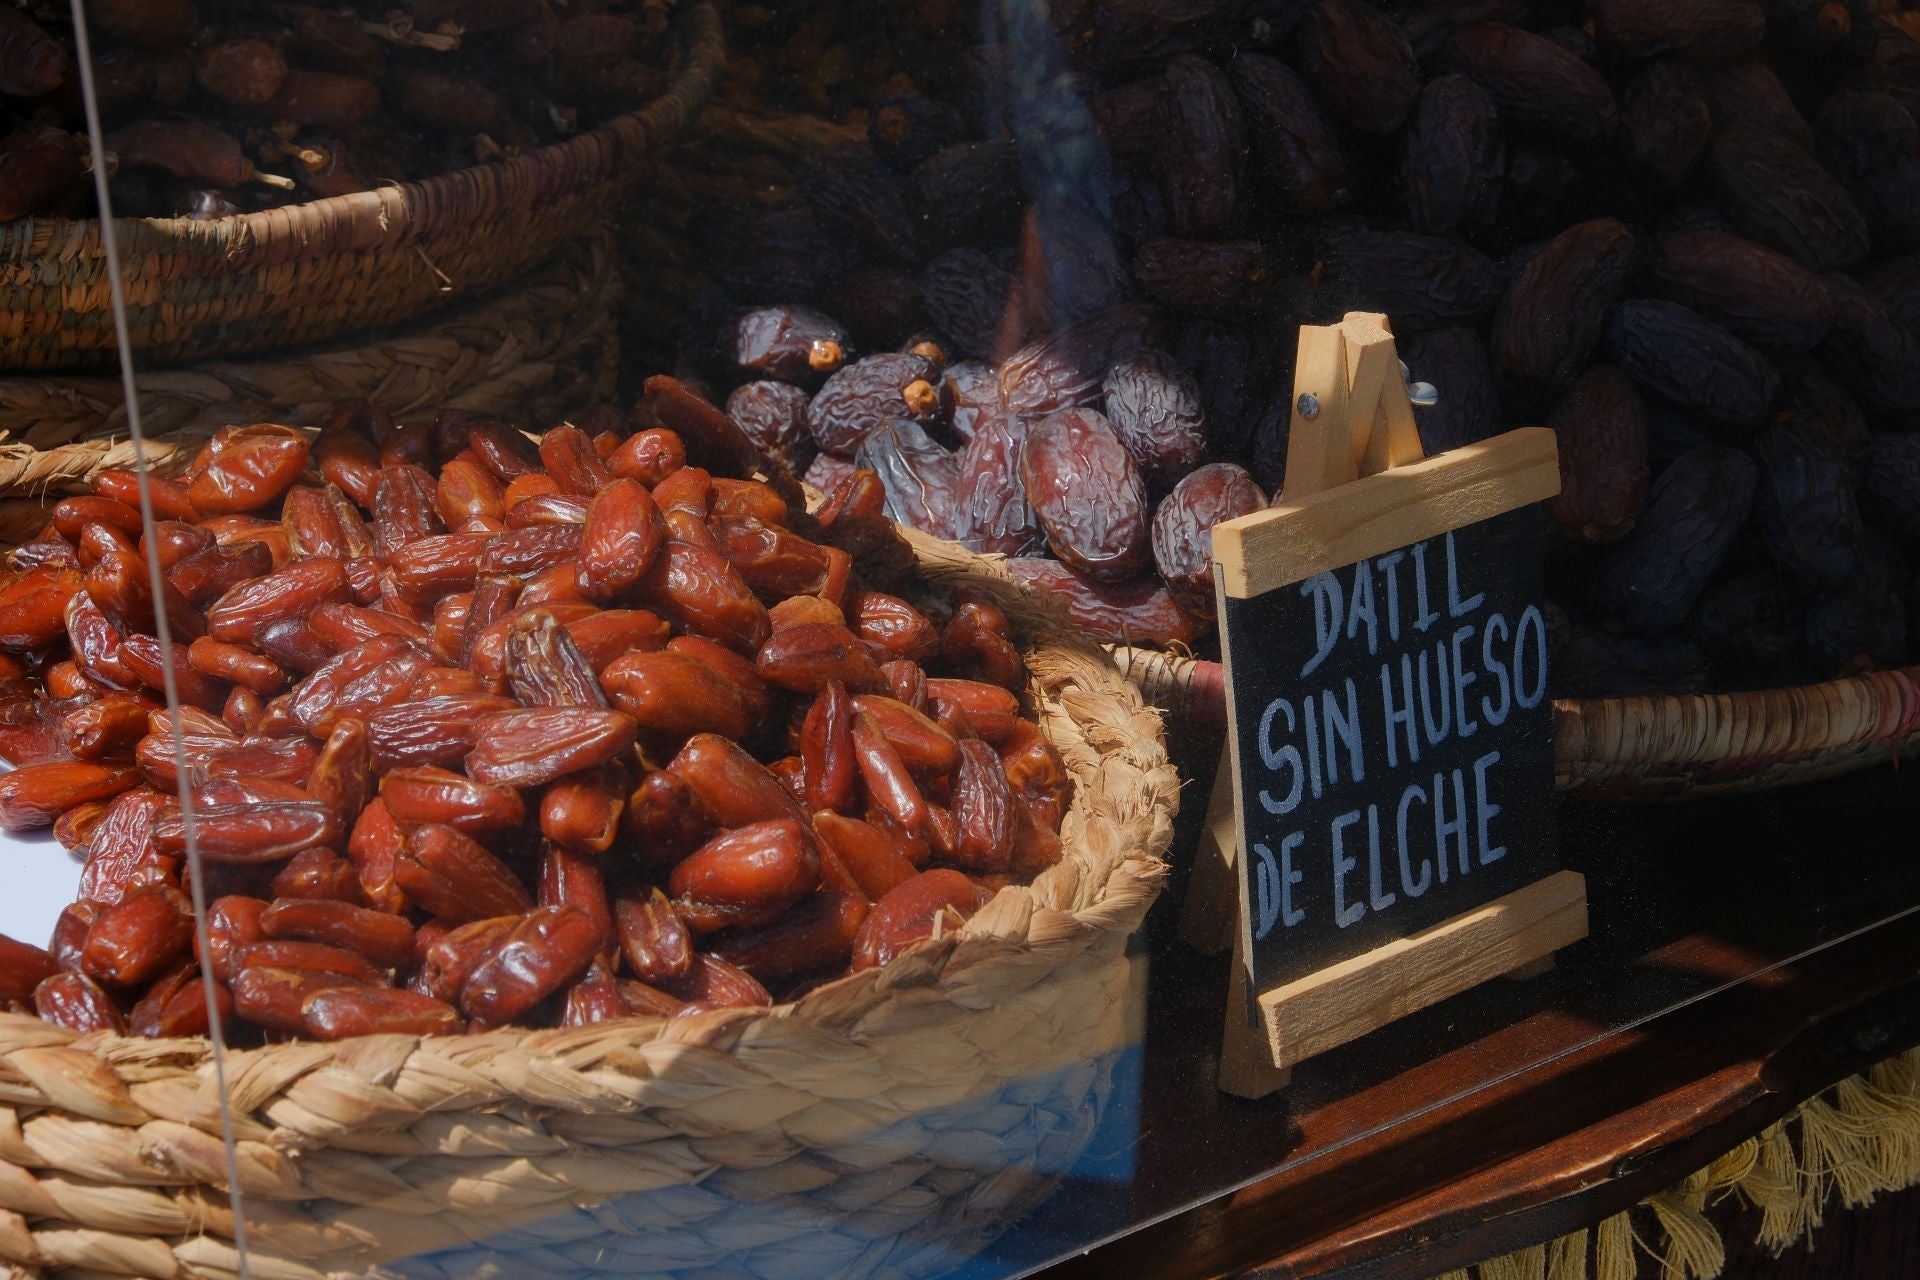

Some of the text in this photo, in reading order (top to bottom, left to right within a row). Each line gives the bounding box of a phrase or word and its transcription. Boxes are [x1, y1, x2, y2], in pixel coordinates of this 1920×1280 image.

[1301, 531, 1486, 679] DATIL
[1258, 604, 1548, 815] SIN HUESO
[1254, 751, 1508, 941] DE ELCHE
